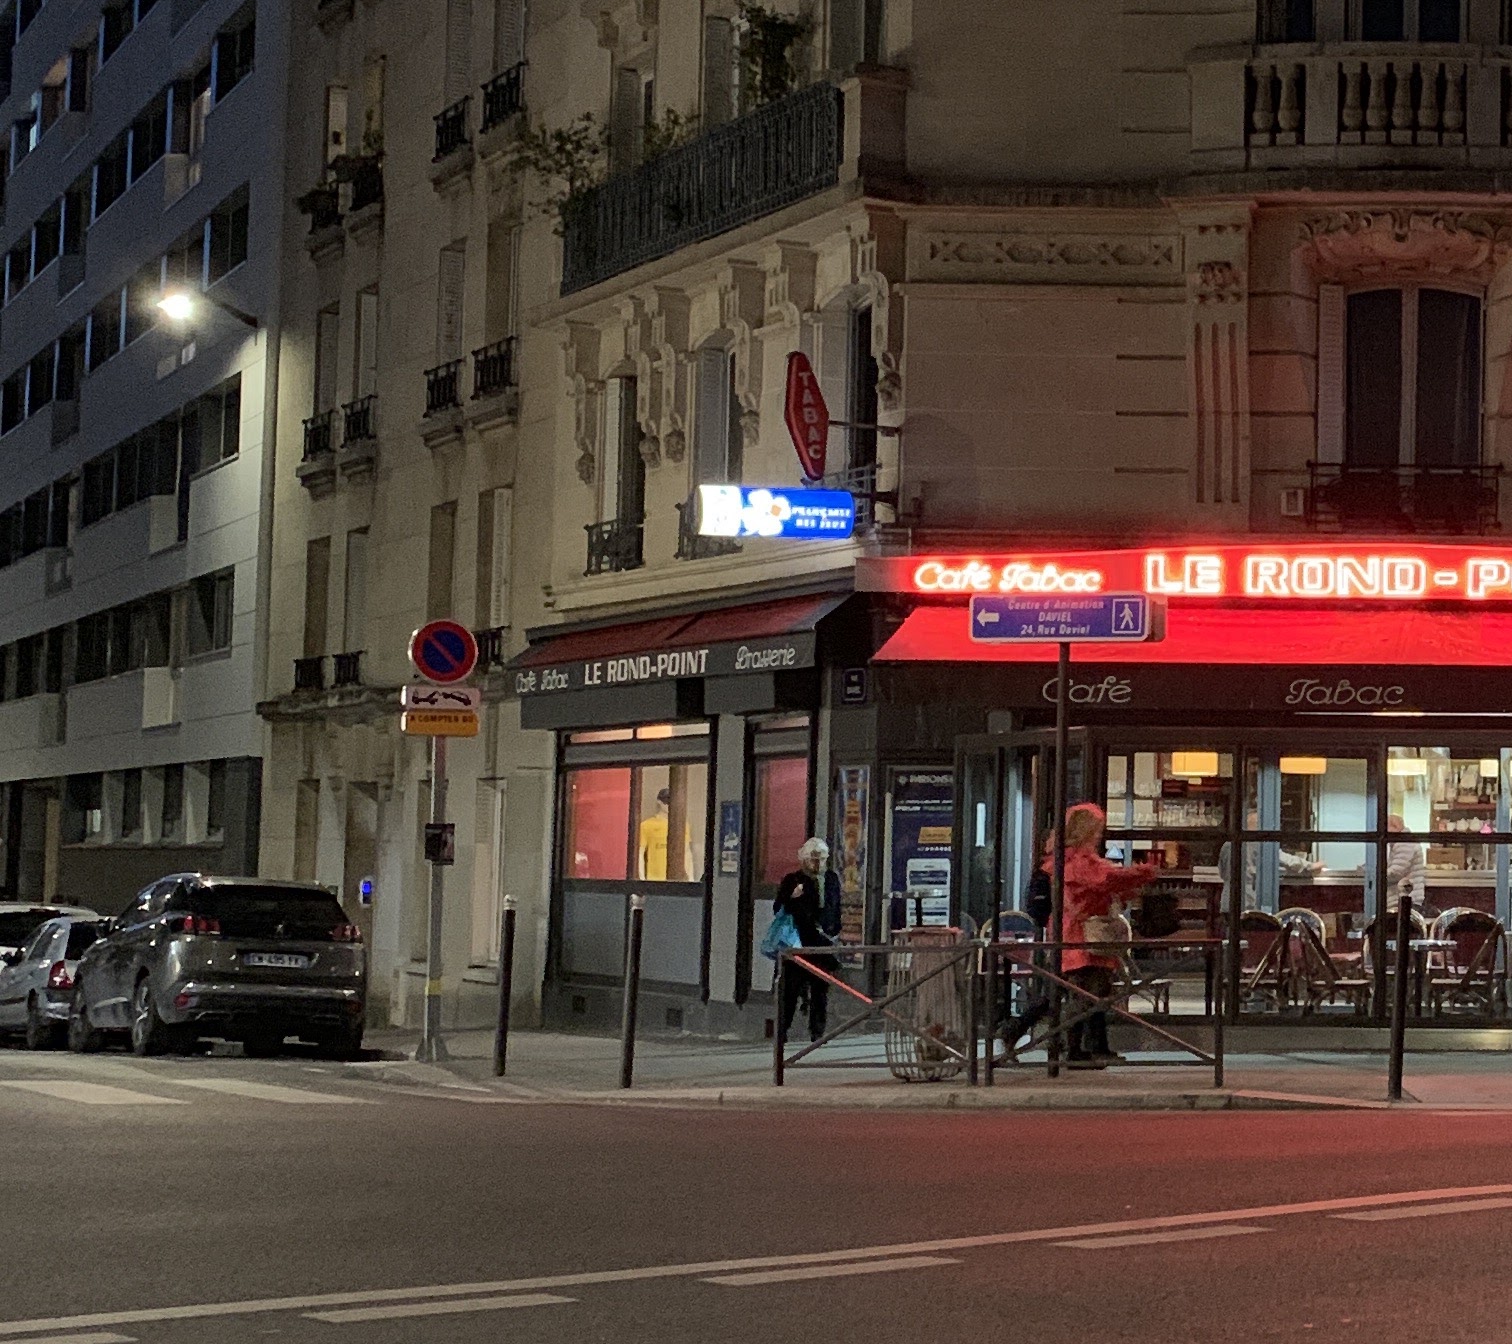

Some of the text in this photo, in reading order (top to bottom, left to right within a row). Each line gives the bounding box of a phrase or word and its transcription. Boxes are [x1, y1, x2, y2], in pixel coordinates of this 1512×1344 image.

[798, 372, 822, 459] TABAC
[914, 560, 992, 591] Café
[998, 560, 1102, 594] Tabac
[1144, 554, 1222, 594] LE
[1008, 599, 1040, 610] Centre
[1038, 611, 1072, 622] DAVIEL
[1020, 624, 1091, 636] 24, Rue Daviel
[516, 672, 537, 694] Café
[584, 662, 602, 686] LE
[606, 649, 709, 683] ROND-POINT
[734, 644, 796, 671] Brasserie
[1042, 675, 1132, 704] Café
[1285, 678, 1405, 705] Tabac
[417, 714, 460, 723] COMPTER
